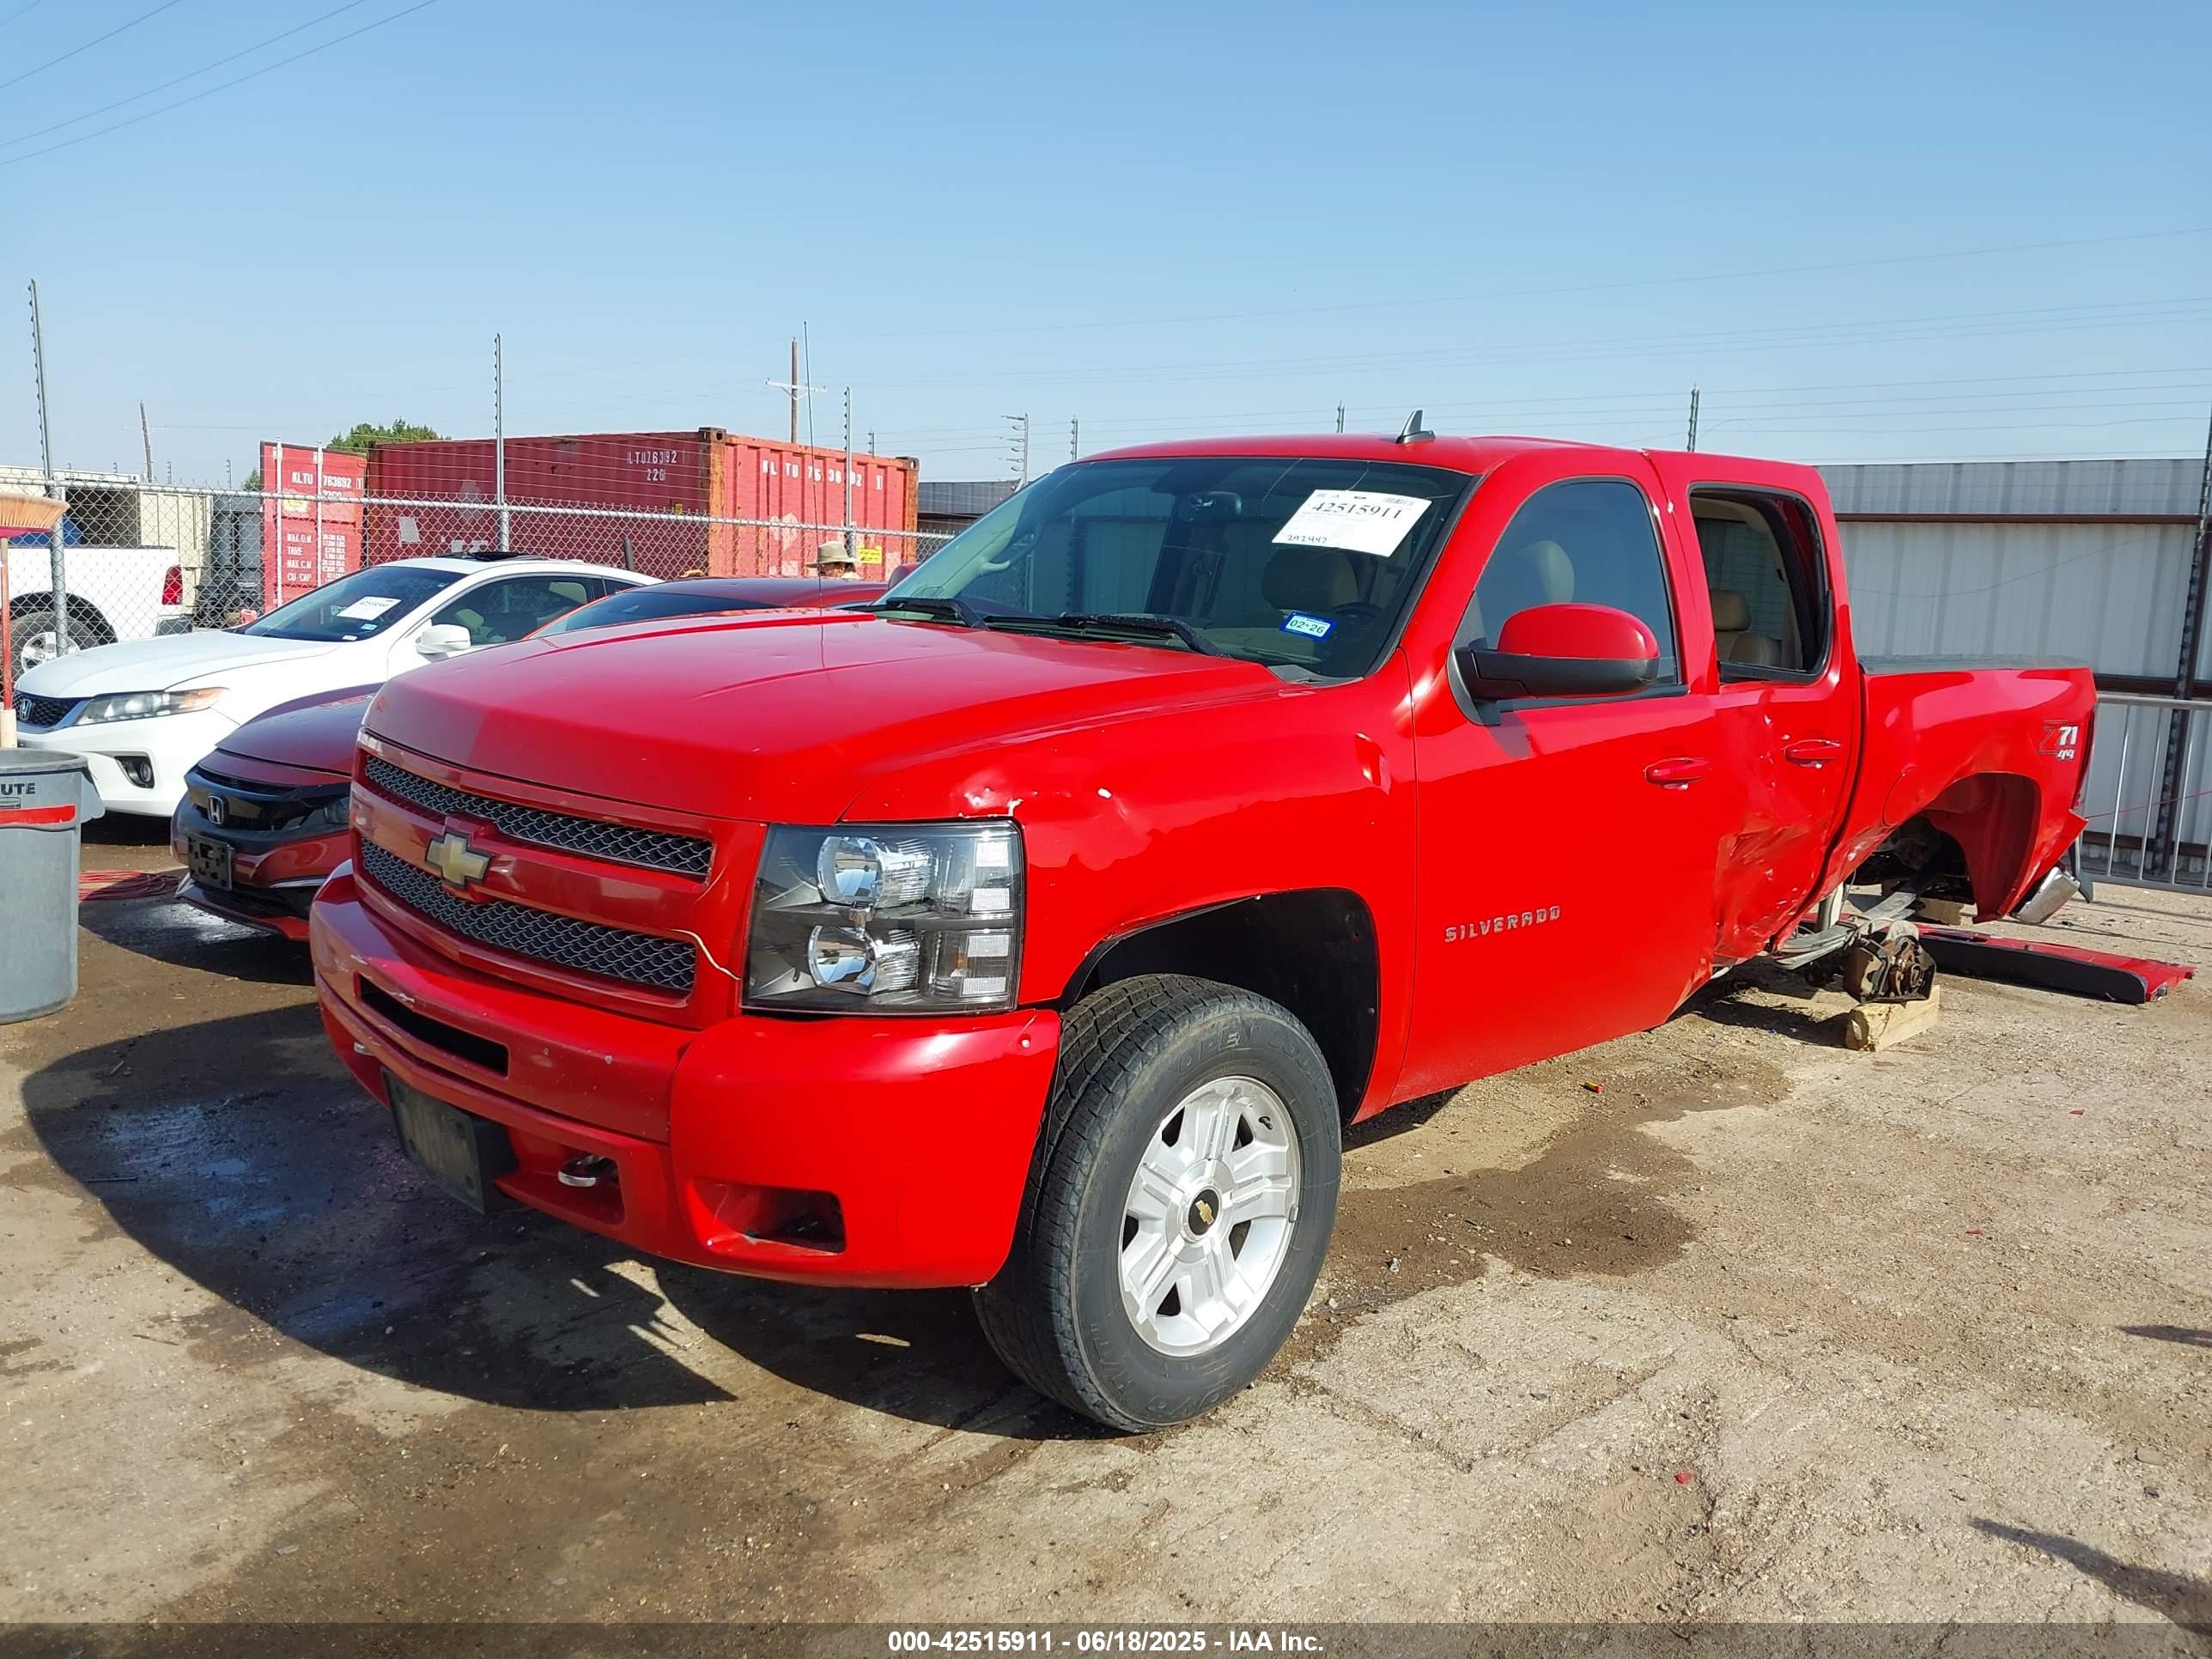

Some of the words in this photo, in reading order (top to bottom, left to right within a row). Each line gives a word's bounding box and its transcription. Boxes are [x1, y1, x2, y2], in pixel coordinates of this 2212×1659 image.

[628, 451, 678, 465] LTU76392
[292, 471, 313, 485] KLTU
[322, 475, 352, 489] 763692
[647, 468, 666, 481] 22G
[1312, 501, 1402, 519] 42515911
[1444, 905, 1560, 943] SILVERADO
